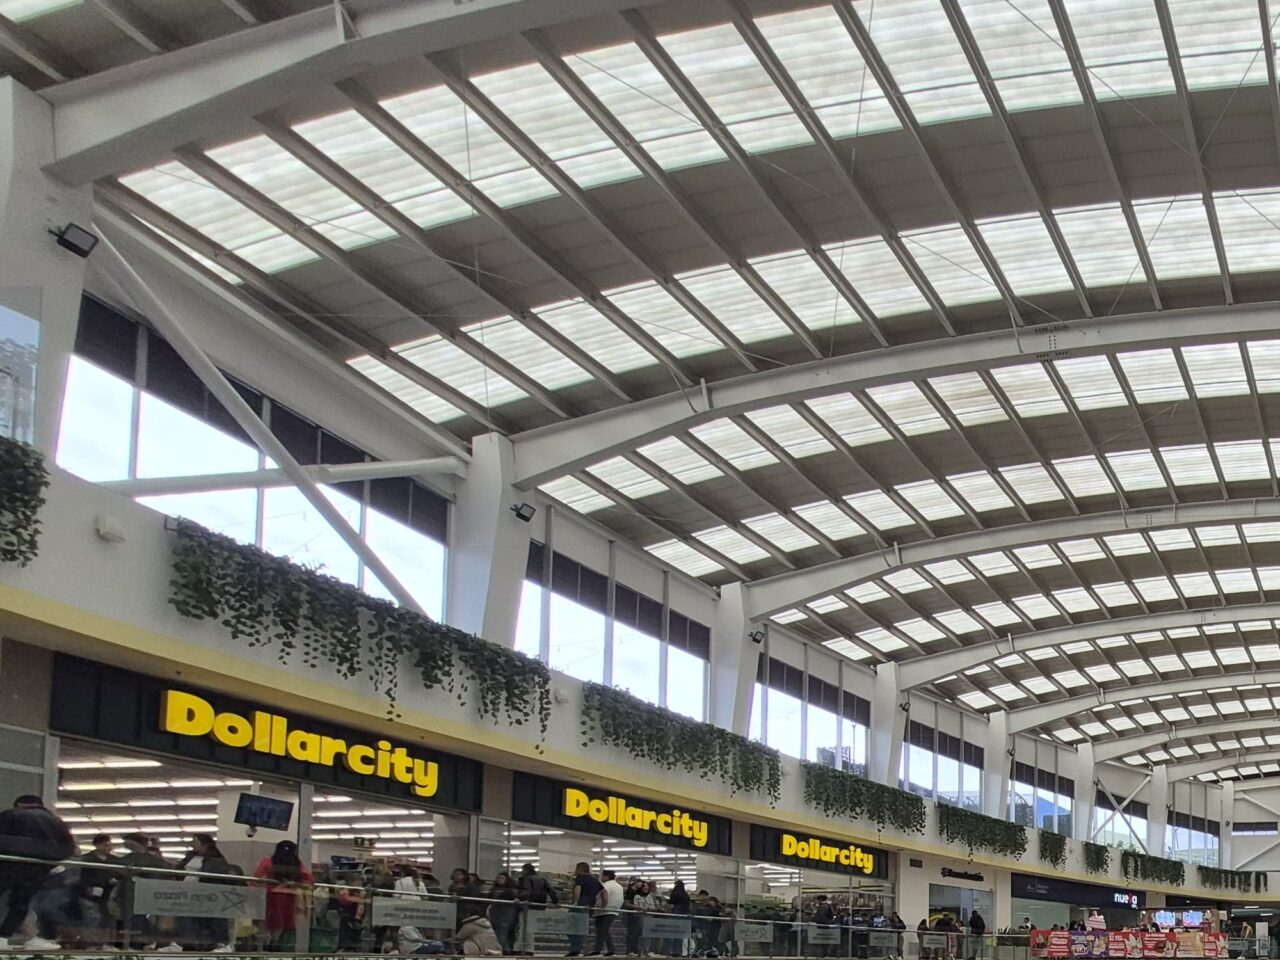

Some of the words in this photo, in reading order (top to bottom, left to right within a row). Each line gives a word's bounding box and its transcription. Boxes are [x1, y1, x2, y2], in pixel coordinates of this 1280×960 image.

[159, 688, 440, 798] Dollarcity
[562, 786, 708, 848] Dollarcity
[781, 833, 874, 875] Dollarcity
